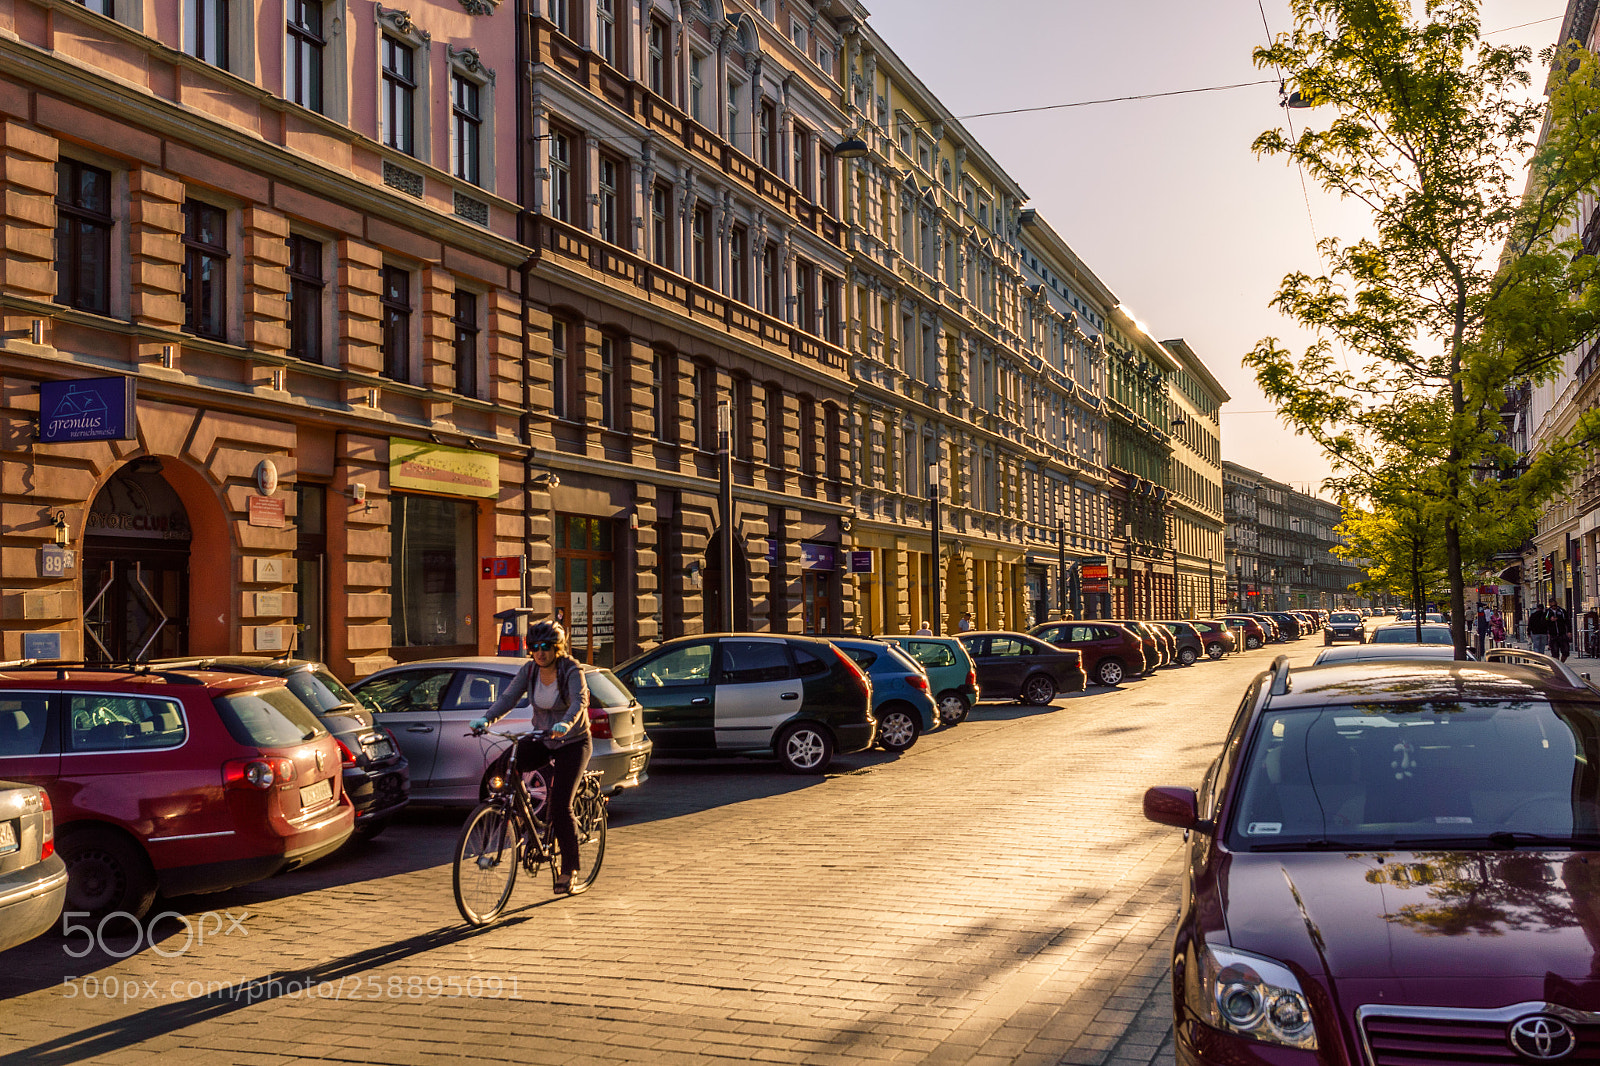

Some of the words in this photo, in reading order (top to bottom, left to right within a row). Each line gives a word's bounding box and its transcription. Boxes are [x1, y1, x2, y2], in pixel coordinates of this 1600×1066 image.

[46, 412, 102, 438] gremius
[45, 555, 62, 572] 89
[505, 622, 513, 634] P
